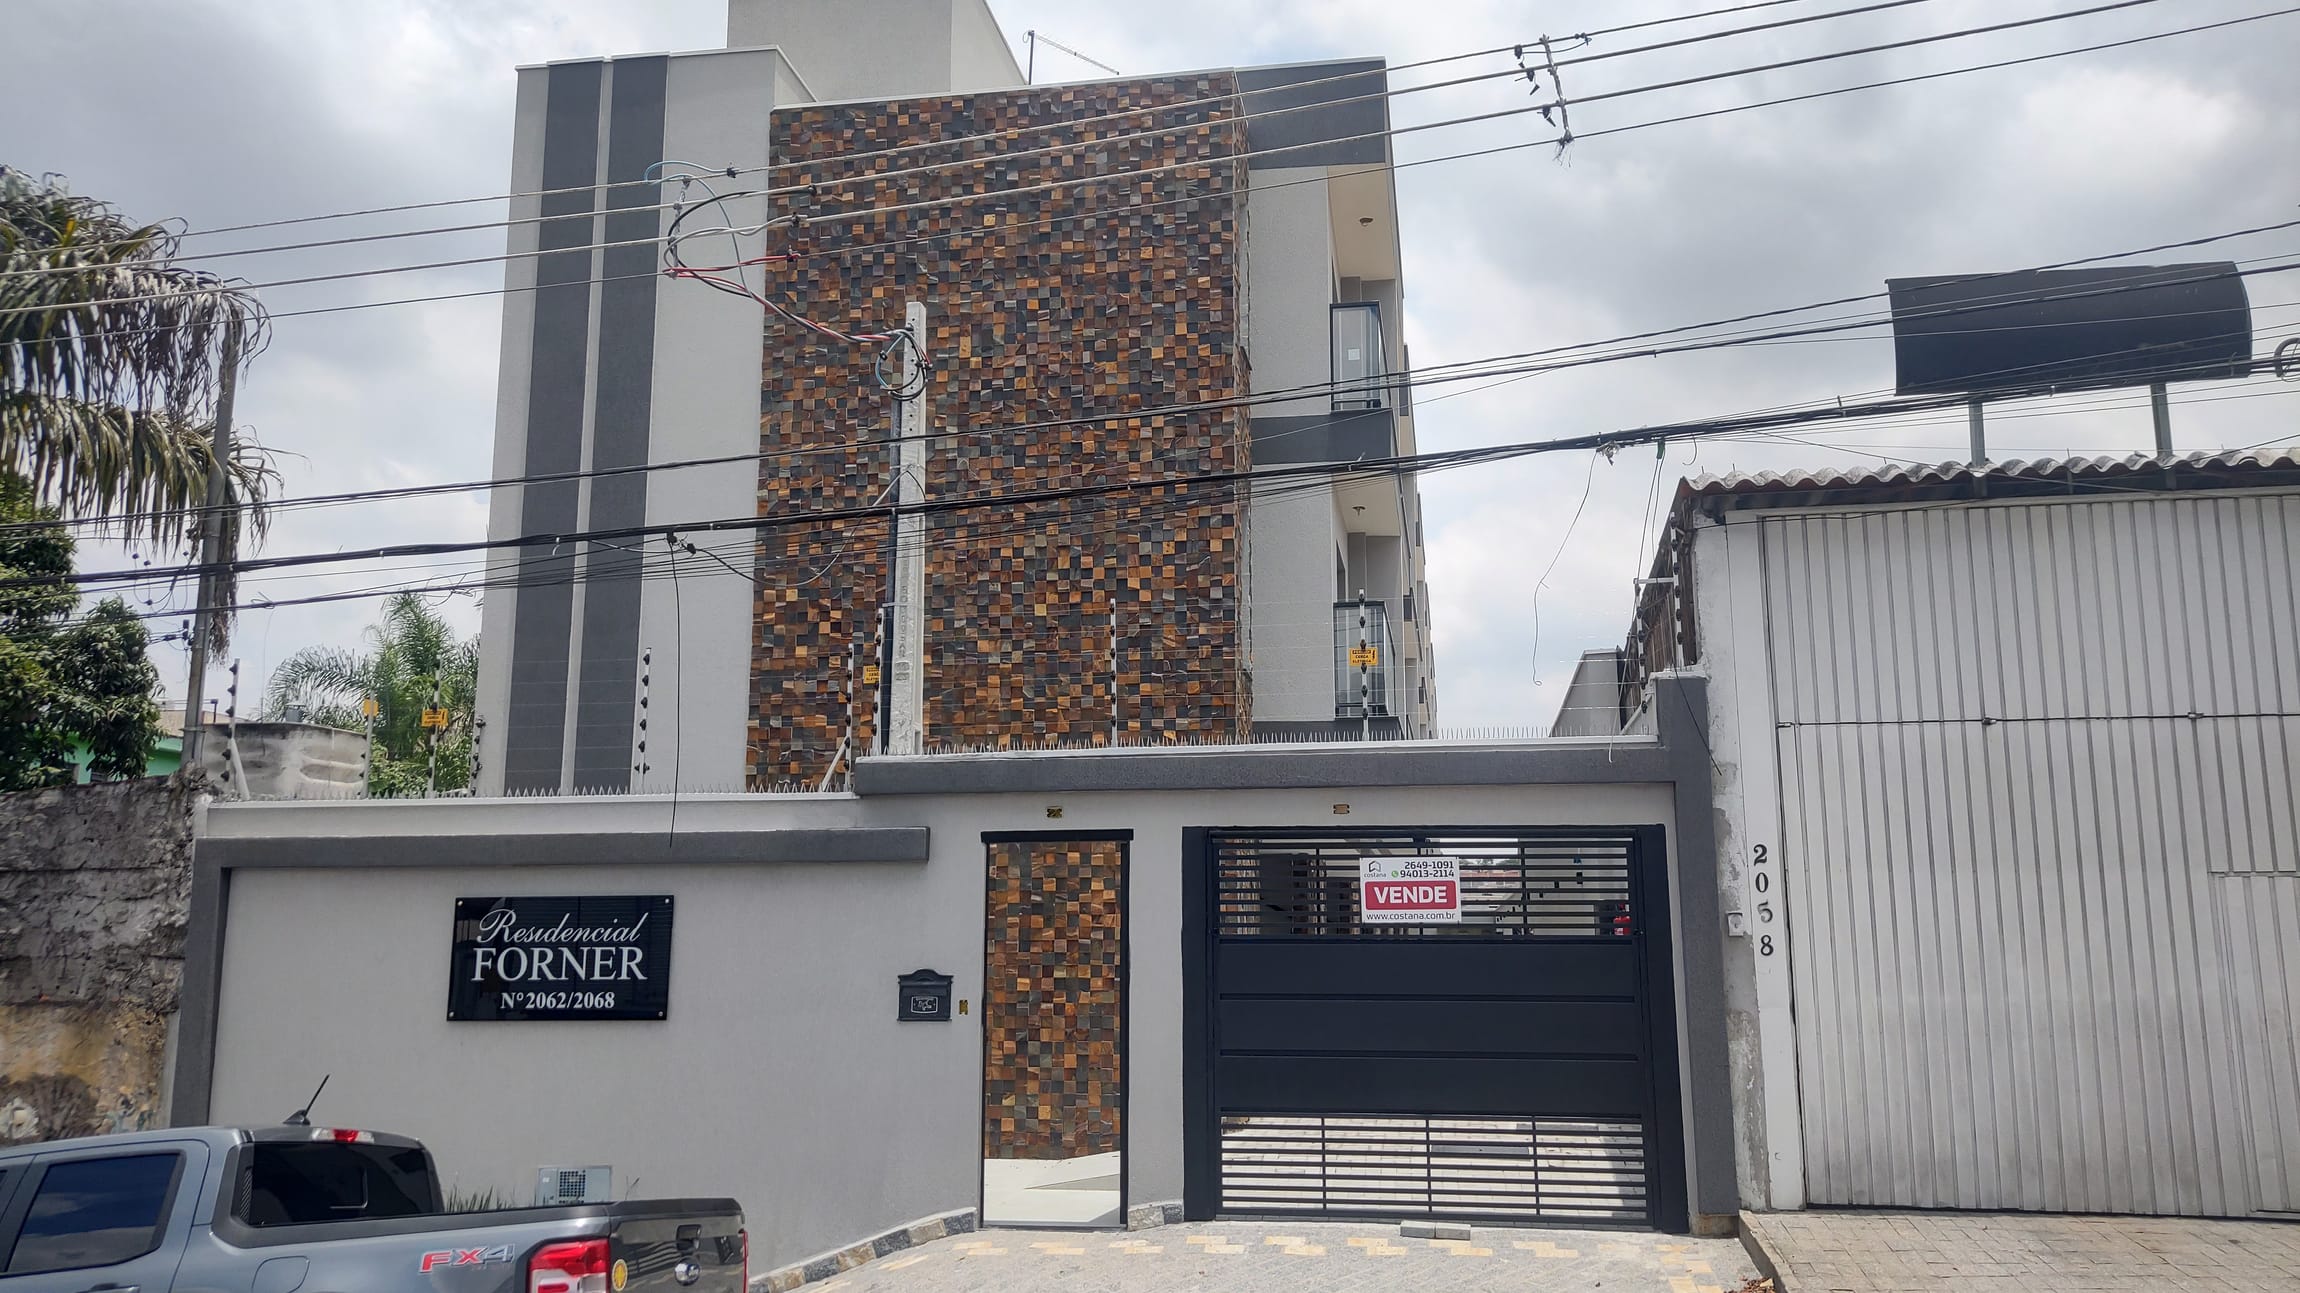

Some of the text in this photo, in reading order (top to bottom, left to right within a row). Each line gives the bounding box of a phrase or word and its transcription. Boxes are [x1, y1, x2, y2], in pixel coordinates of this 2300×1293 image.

[1400, 869, 1455, 878] 94013-2114
[1404, 861, 1454, 870] 2649-1091
[1373, 885, 1448, 904] VENDE
[1753, 843, 1774, 957] 2058
[476, 908, 649, 944] Residencial
[1366, 911, 1455, 921] www.costana.com.br
[471, 946, 648, 982] FORNER
[419, 1244, 515, 1273] FX4
